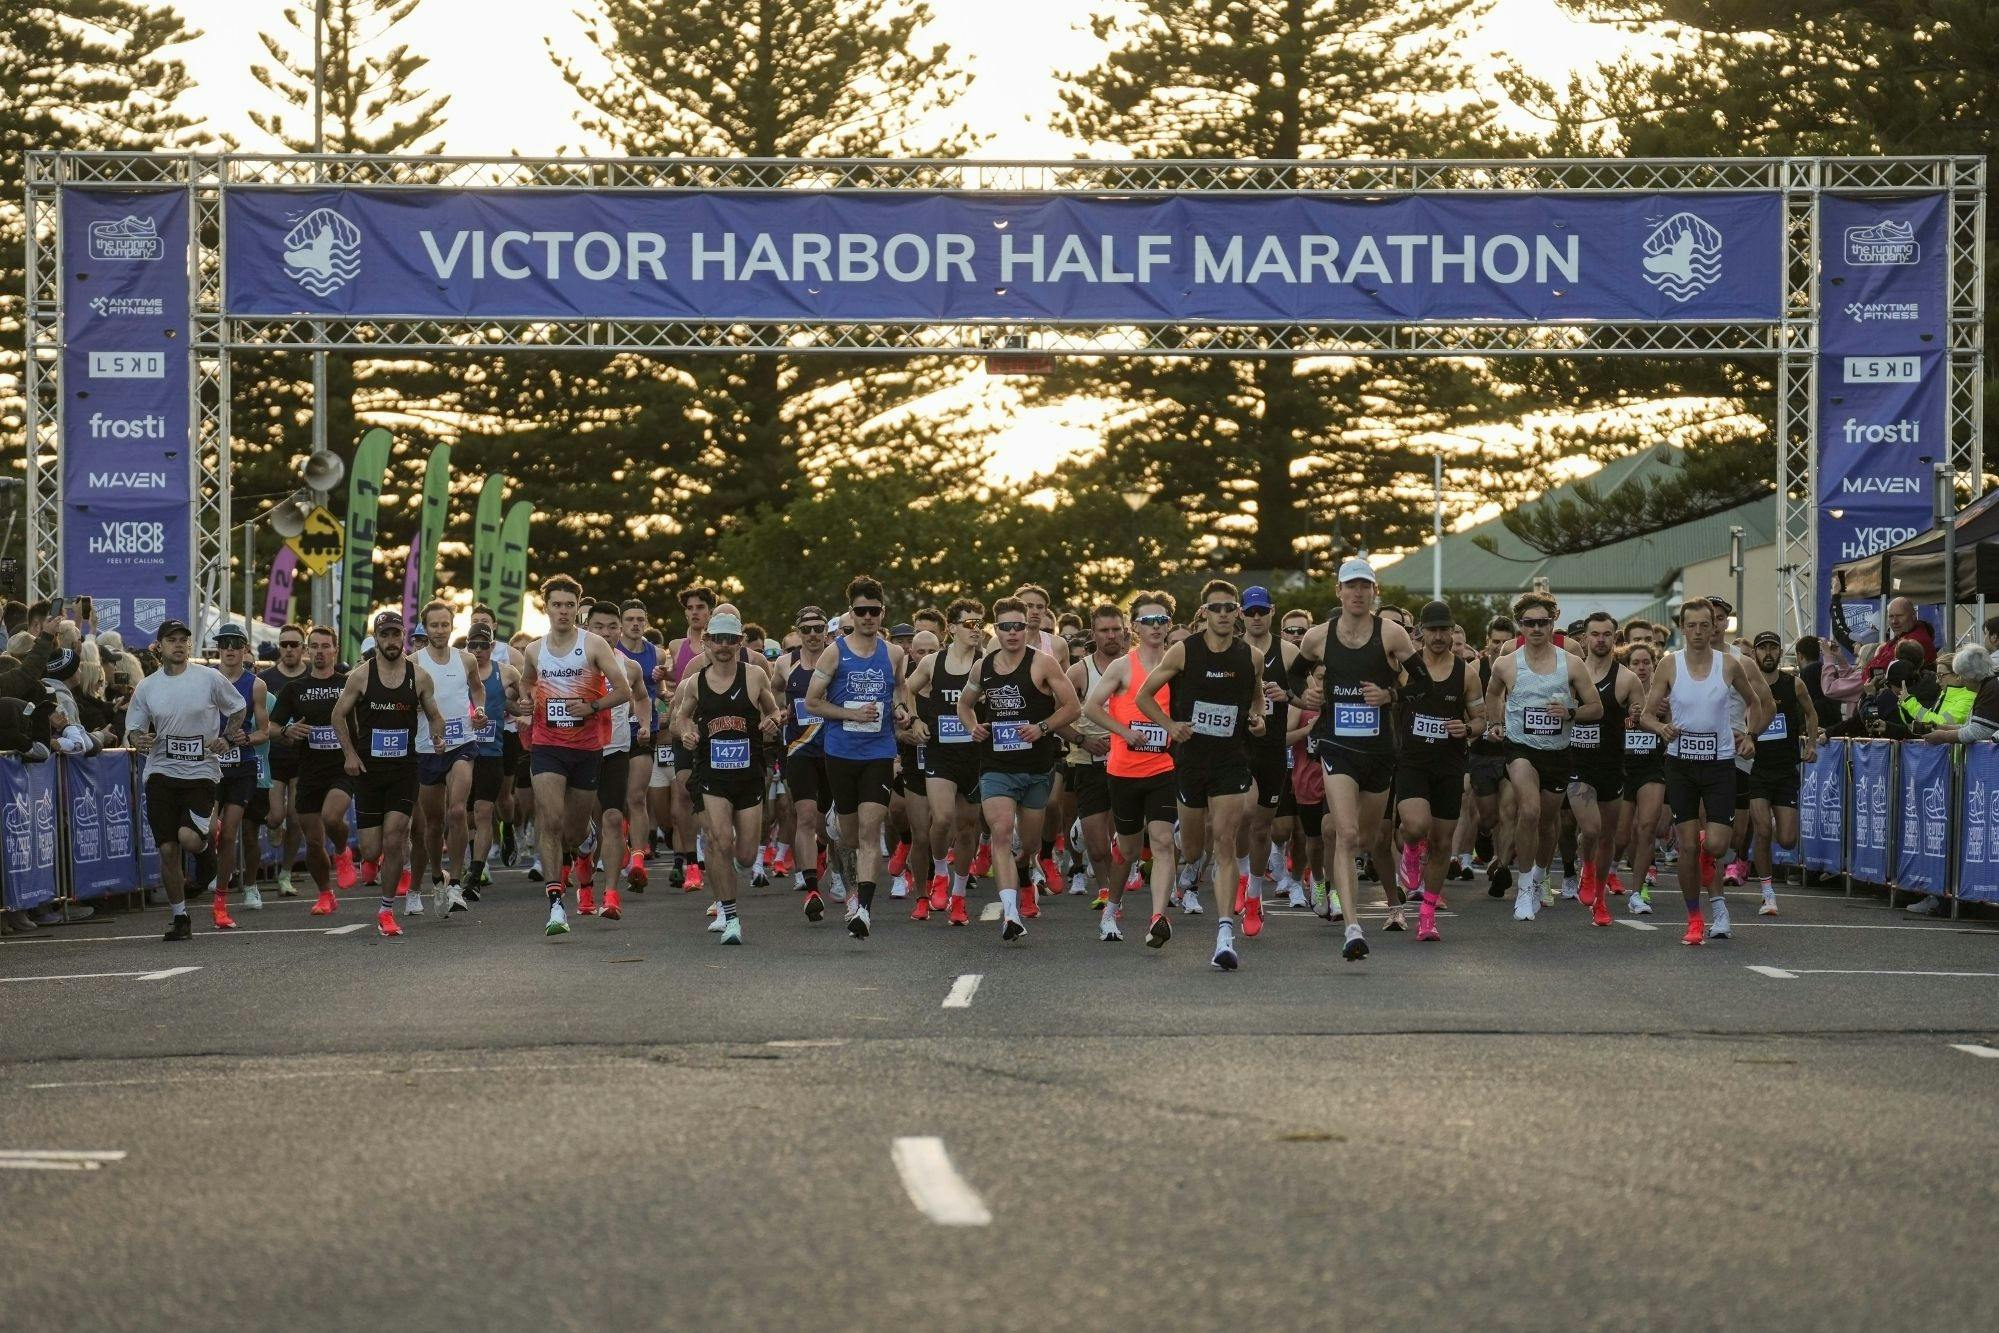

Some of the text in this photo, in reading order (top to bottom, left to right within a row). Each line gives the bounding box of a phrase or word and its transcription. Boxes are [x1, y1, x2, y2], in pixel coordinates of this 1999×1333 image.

[96, 239, 157, 251] the running
[1851, 244, 1913, 255] the running
[419, 230, 1579, 284] VICTOR HARBOR HALF MARATHON
[108, 298, 163, 306] ANYTIME
[1863, 303, 1919, 311] ANYTIME
[108, 306, 163, 315] FITNESS
[1863, 311, 1919, 320] FITNESS
[88, 412, 166, 439] frosti
[1842, 417, 1920, 444] frosti
[89, 472, 166, 489] MAVEN
[1842, 477, 1921, 493] MAVEN
[101, 521, 164, 538] VICTOR
[89, 536, 164, 553] HARBOR
[1197, 712, 1231, 728] 9153
[1340, 710, 1375, 724] 2198
[1527, 714, 1560, 725] 3505
[1416, 720, 1446, 735] 3169
[382, 736, 399, 747] 82
[1627, 735, 1655, 745] 3727
[1681, 738, 1714, 751] 3509
[171, 742, 200, 753] 3617
[715, 746, 745, 758] 1477
[1681, 753, 1714, 761] HARRISON
[716, 761, 745, 769] ROUTLEY
